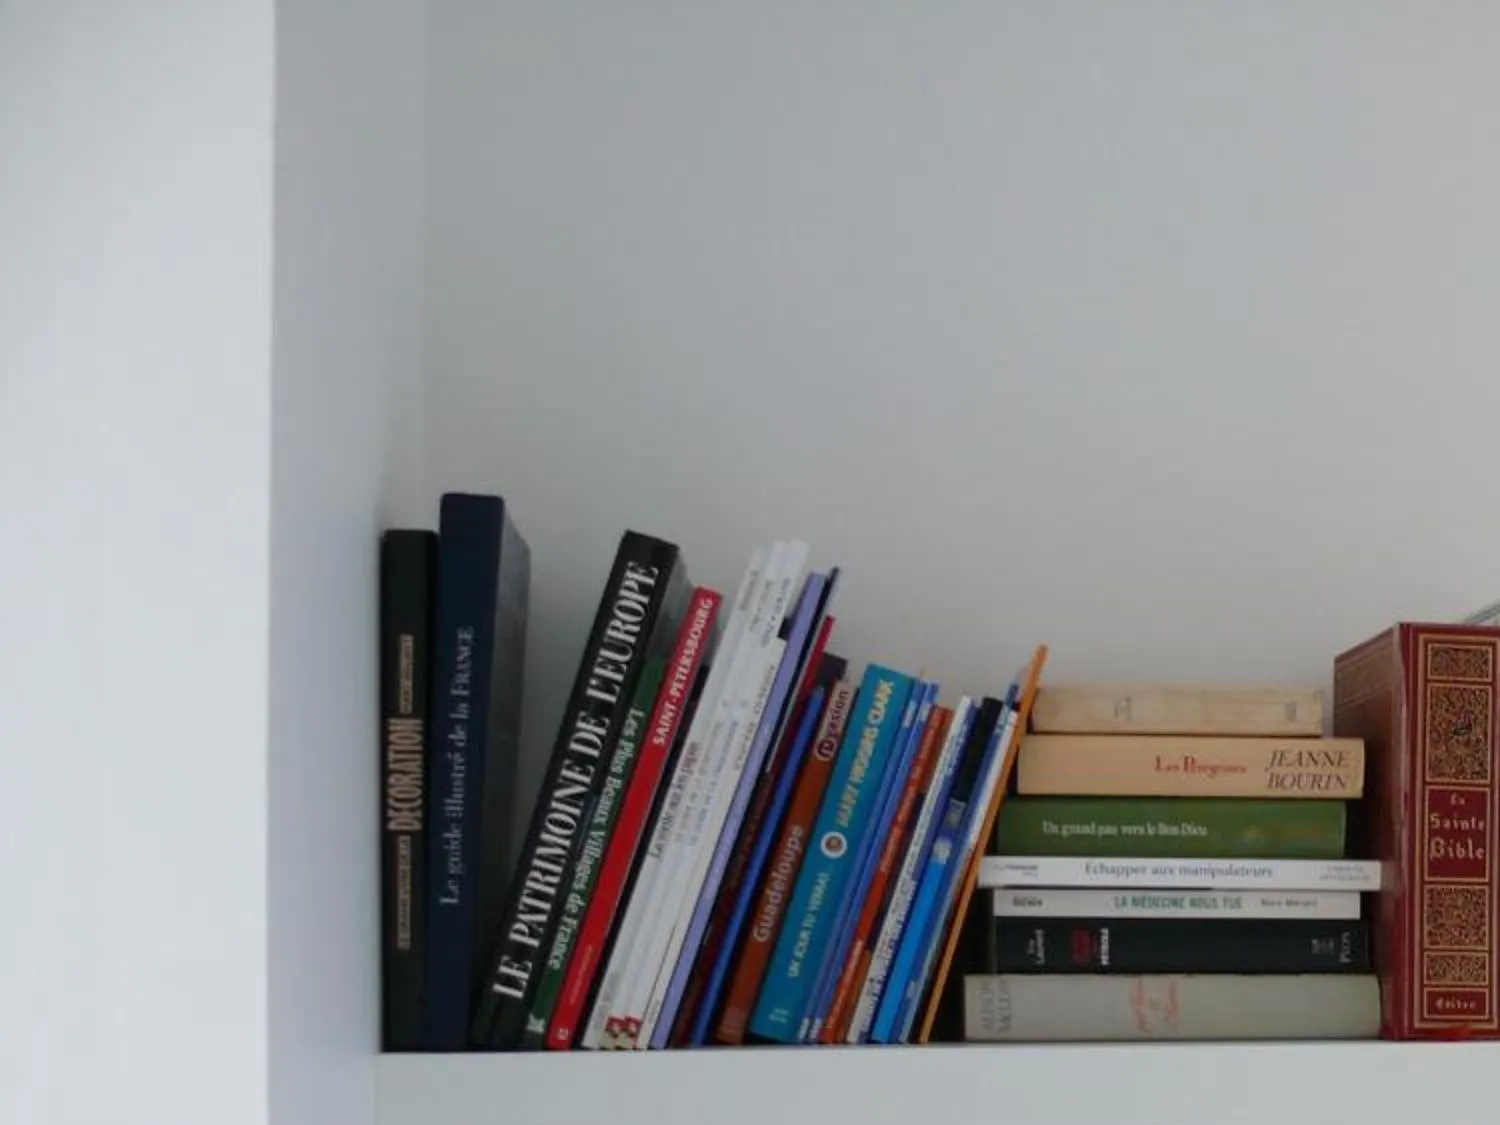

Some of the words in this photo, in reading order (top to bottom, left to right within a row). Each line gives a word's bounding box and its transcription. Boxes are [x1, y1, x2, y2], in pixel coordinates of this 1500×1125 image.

[584, 559, 659, 705] L'EUROPE
[449, 701, 469, 719] la
[621, 706, 644, 738] Les
[448, 724, 468, 747] de
[567, 710, 611, 758] DE
[387, 717, 423, 830] DECORATION
[608, 738, 635, 775] Plus
[1265, 749, 1349, 771] JEANNE
[1268, 772, 1347, 790] BOURIN
[593, 774, 622, 826] Beaux
[1429, 812, 1485, 831] Sainte
[441, 823, 465, 875] guide
[505, 758, 597, 949] PATRIMOINE
[570, 826, 606, 893] Villages
[1429, 836, 1485, 862] Bible
[1151, 865, 1174, 874] aux
[1178, 862, 1272, 879] manipulateurs
[439, 879, 459, 903] Le
[563, 892, 585, 915] de
[546, 914, 577, 970] France
[490, 952, 534, 1000] LE
